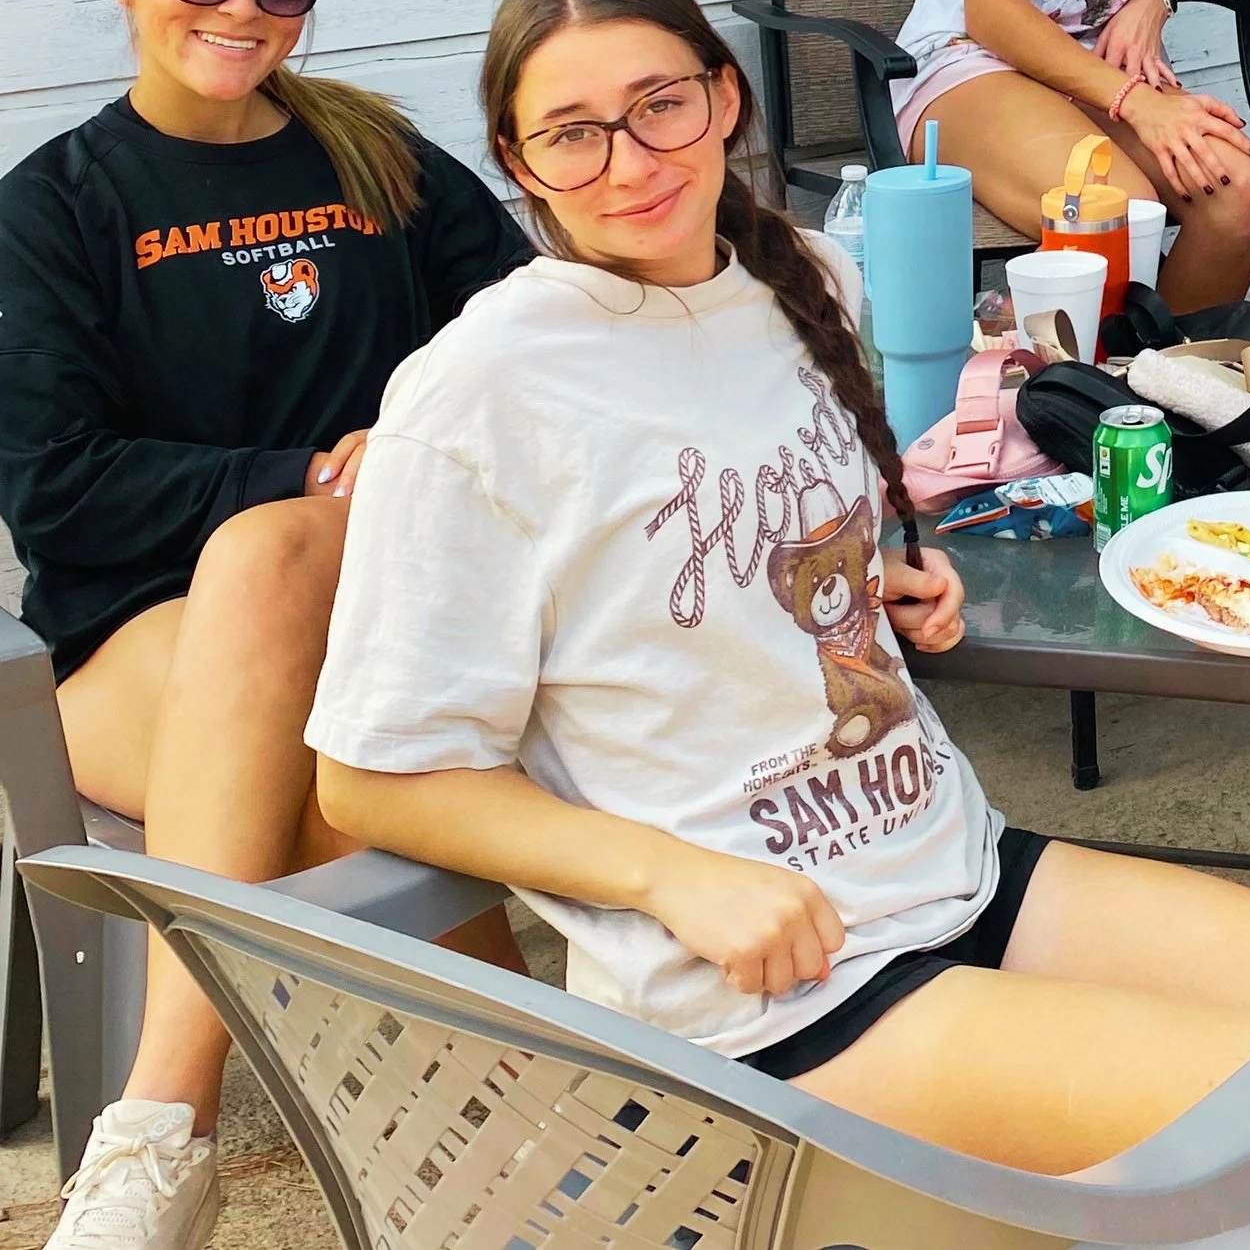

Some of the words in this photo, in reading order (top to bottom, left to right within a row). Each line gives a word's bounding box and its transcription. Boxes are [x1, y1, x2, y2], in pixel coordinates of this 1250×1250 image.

[135, 222, 222, 270] SAM
[221, 234, 336, 266] SOFTBALL
[751, 753, 789, 776] FROM
[789, 743, 818, 762] THE
[750, 769, 858, 854] SAM
[787, 826, 870, 872] STATE
